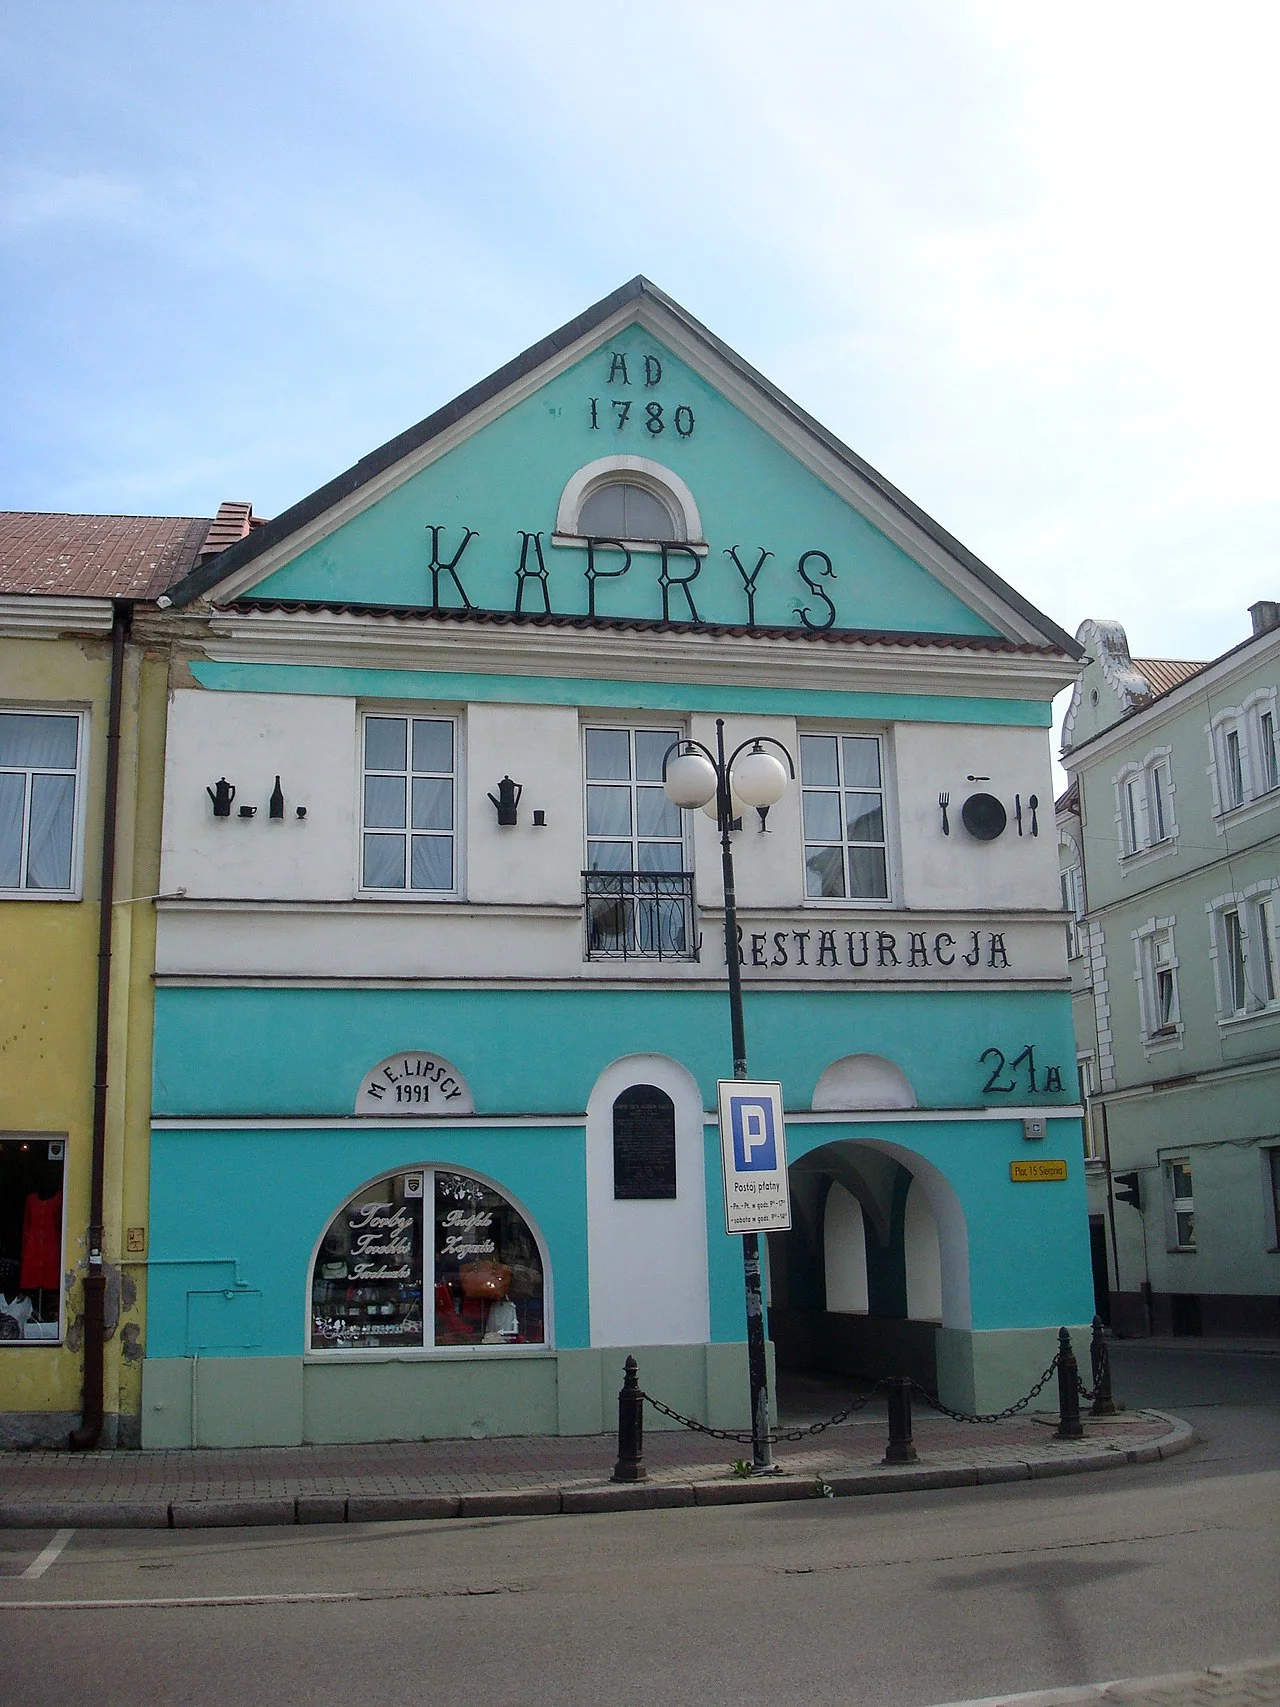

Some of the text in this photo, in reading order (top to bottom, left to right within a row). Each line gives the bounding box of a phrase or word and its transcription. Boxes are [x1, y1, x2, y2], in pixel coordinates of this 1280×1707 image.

[588, 397, 696, 438] 1780
[425, 525, 838, 631] KAPRYS
[395, 1084, 430, 1103] 1991
[740, 1104, 767, 1163] P
[734, 1180, 780, 1194] Postój płatny
[1015, 1165, 1063, 1177] Plac 15 Sierpnia
[349, 1202, 414, 1238] Torby
